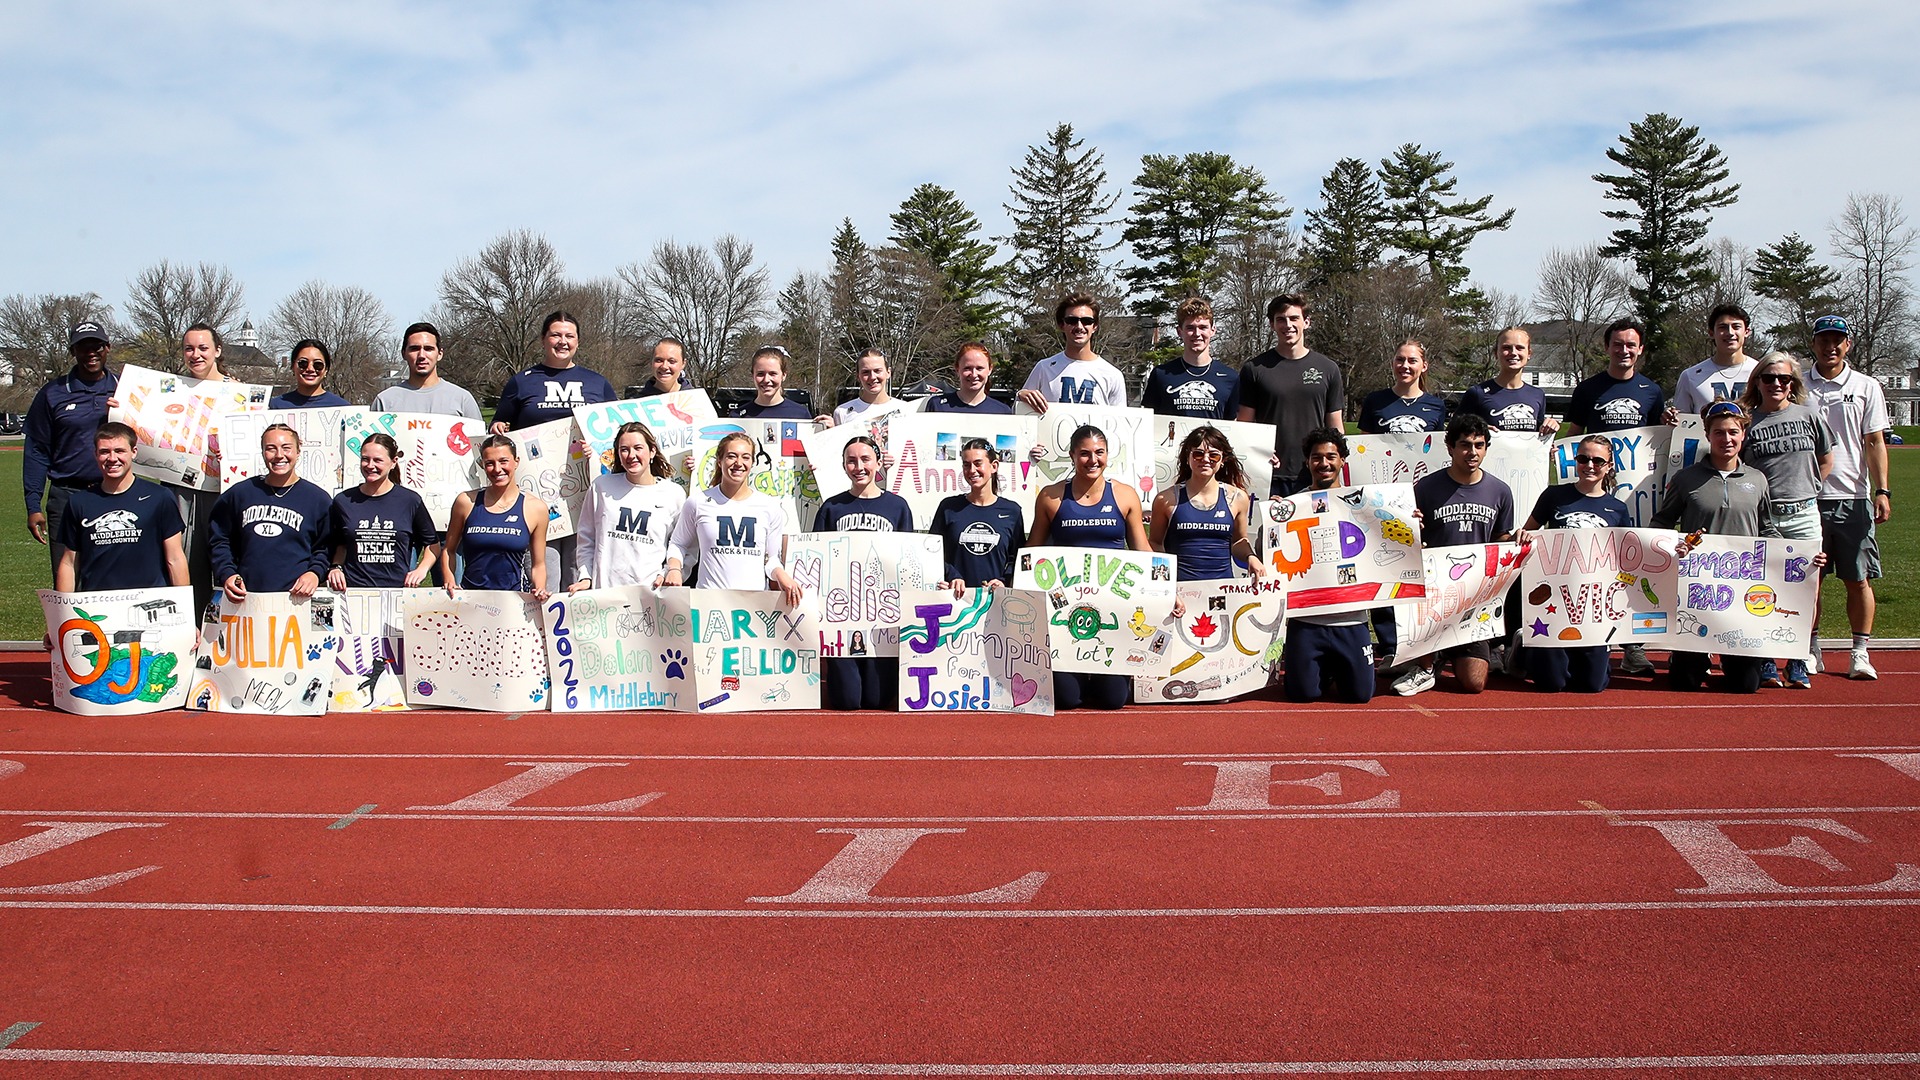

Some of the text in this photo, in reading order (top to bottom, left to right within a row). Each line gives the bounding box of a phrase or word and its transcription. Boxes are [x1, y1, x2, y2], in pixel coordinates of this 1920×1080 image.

[544, 381, 585, 402] M
[1059, 376, 1097, 403] M
[1843, 394, 1854, 402] M
[1173, 398, 1219, 407] MIDDLEBURY
[346, 412, 363, 427] CEO
[407, 419, 432, 431] NYC
[587, 399, 666, 440] CATE
[1499, 418, 1537, 426] MIDDLEBURY
[1749, 419, 1815, 444] MIDDLEBURY
[1557, 435, 1642, 479] HRY
[1751, 440, 1780, 459] TRACK
[1783, 440, 1791, 451] &
[242, 505, 304, 532] MIDDLEBURY
[616, 507, 651, 535] M
[1433, 503, 1498, 520] MIDDLEBURY
[1442, 515, 1464, 523] TRACK
[1471, 515, 1491, 524] FIELD
[262, 525, 274, 535] XL
[358, 520, 394, 529] 20 23
[467, 526, 522, 536] MIDDLEBURY
[716, 516, 757, 548] M
[1061, 518, 1117, 527] MIDDLEBURY
[1177, 522, 1231, 531] MIDDLEBURY
[1459, 521, 1473, 532] M
[90, 529, 142, 541] MIDDLEBURY
[607, 531, 631, 541] TRACK
[635, 534, 655, 545] FIELD
[790, 533, 816, 542] TWIN
[357, 542, 396, 554] NESCAC
[743, 549, 762, 557] FIELD
[1272, 516, 1366, 582] JED
[1536, 529, 1673, 576] VAMOS
[357, 554, 396, 564] CHAMPIONS
[1784, 545, 1809, 583] is
[1034, 553, 1144, 600] OLIVE
[1074, 584, 1100, 602] you
[1559, 581, 1628, 625] VIC
[1687, 583, 1735, 611] RAD
[212, 614, 304, 670] JULIA
[58, 618, 142, 696] OJ
[579, 639, 652, 680] Dolan
[722, 647, 817, 677] ELLIOT
[947, 656, 980, 680] for
[150, 684, 164, 693] M
[244, 677, 293, 714] MEOW
[589, 681, 678, 708] Middlebury
[904, 666, 991, 711] Josie!
